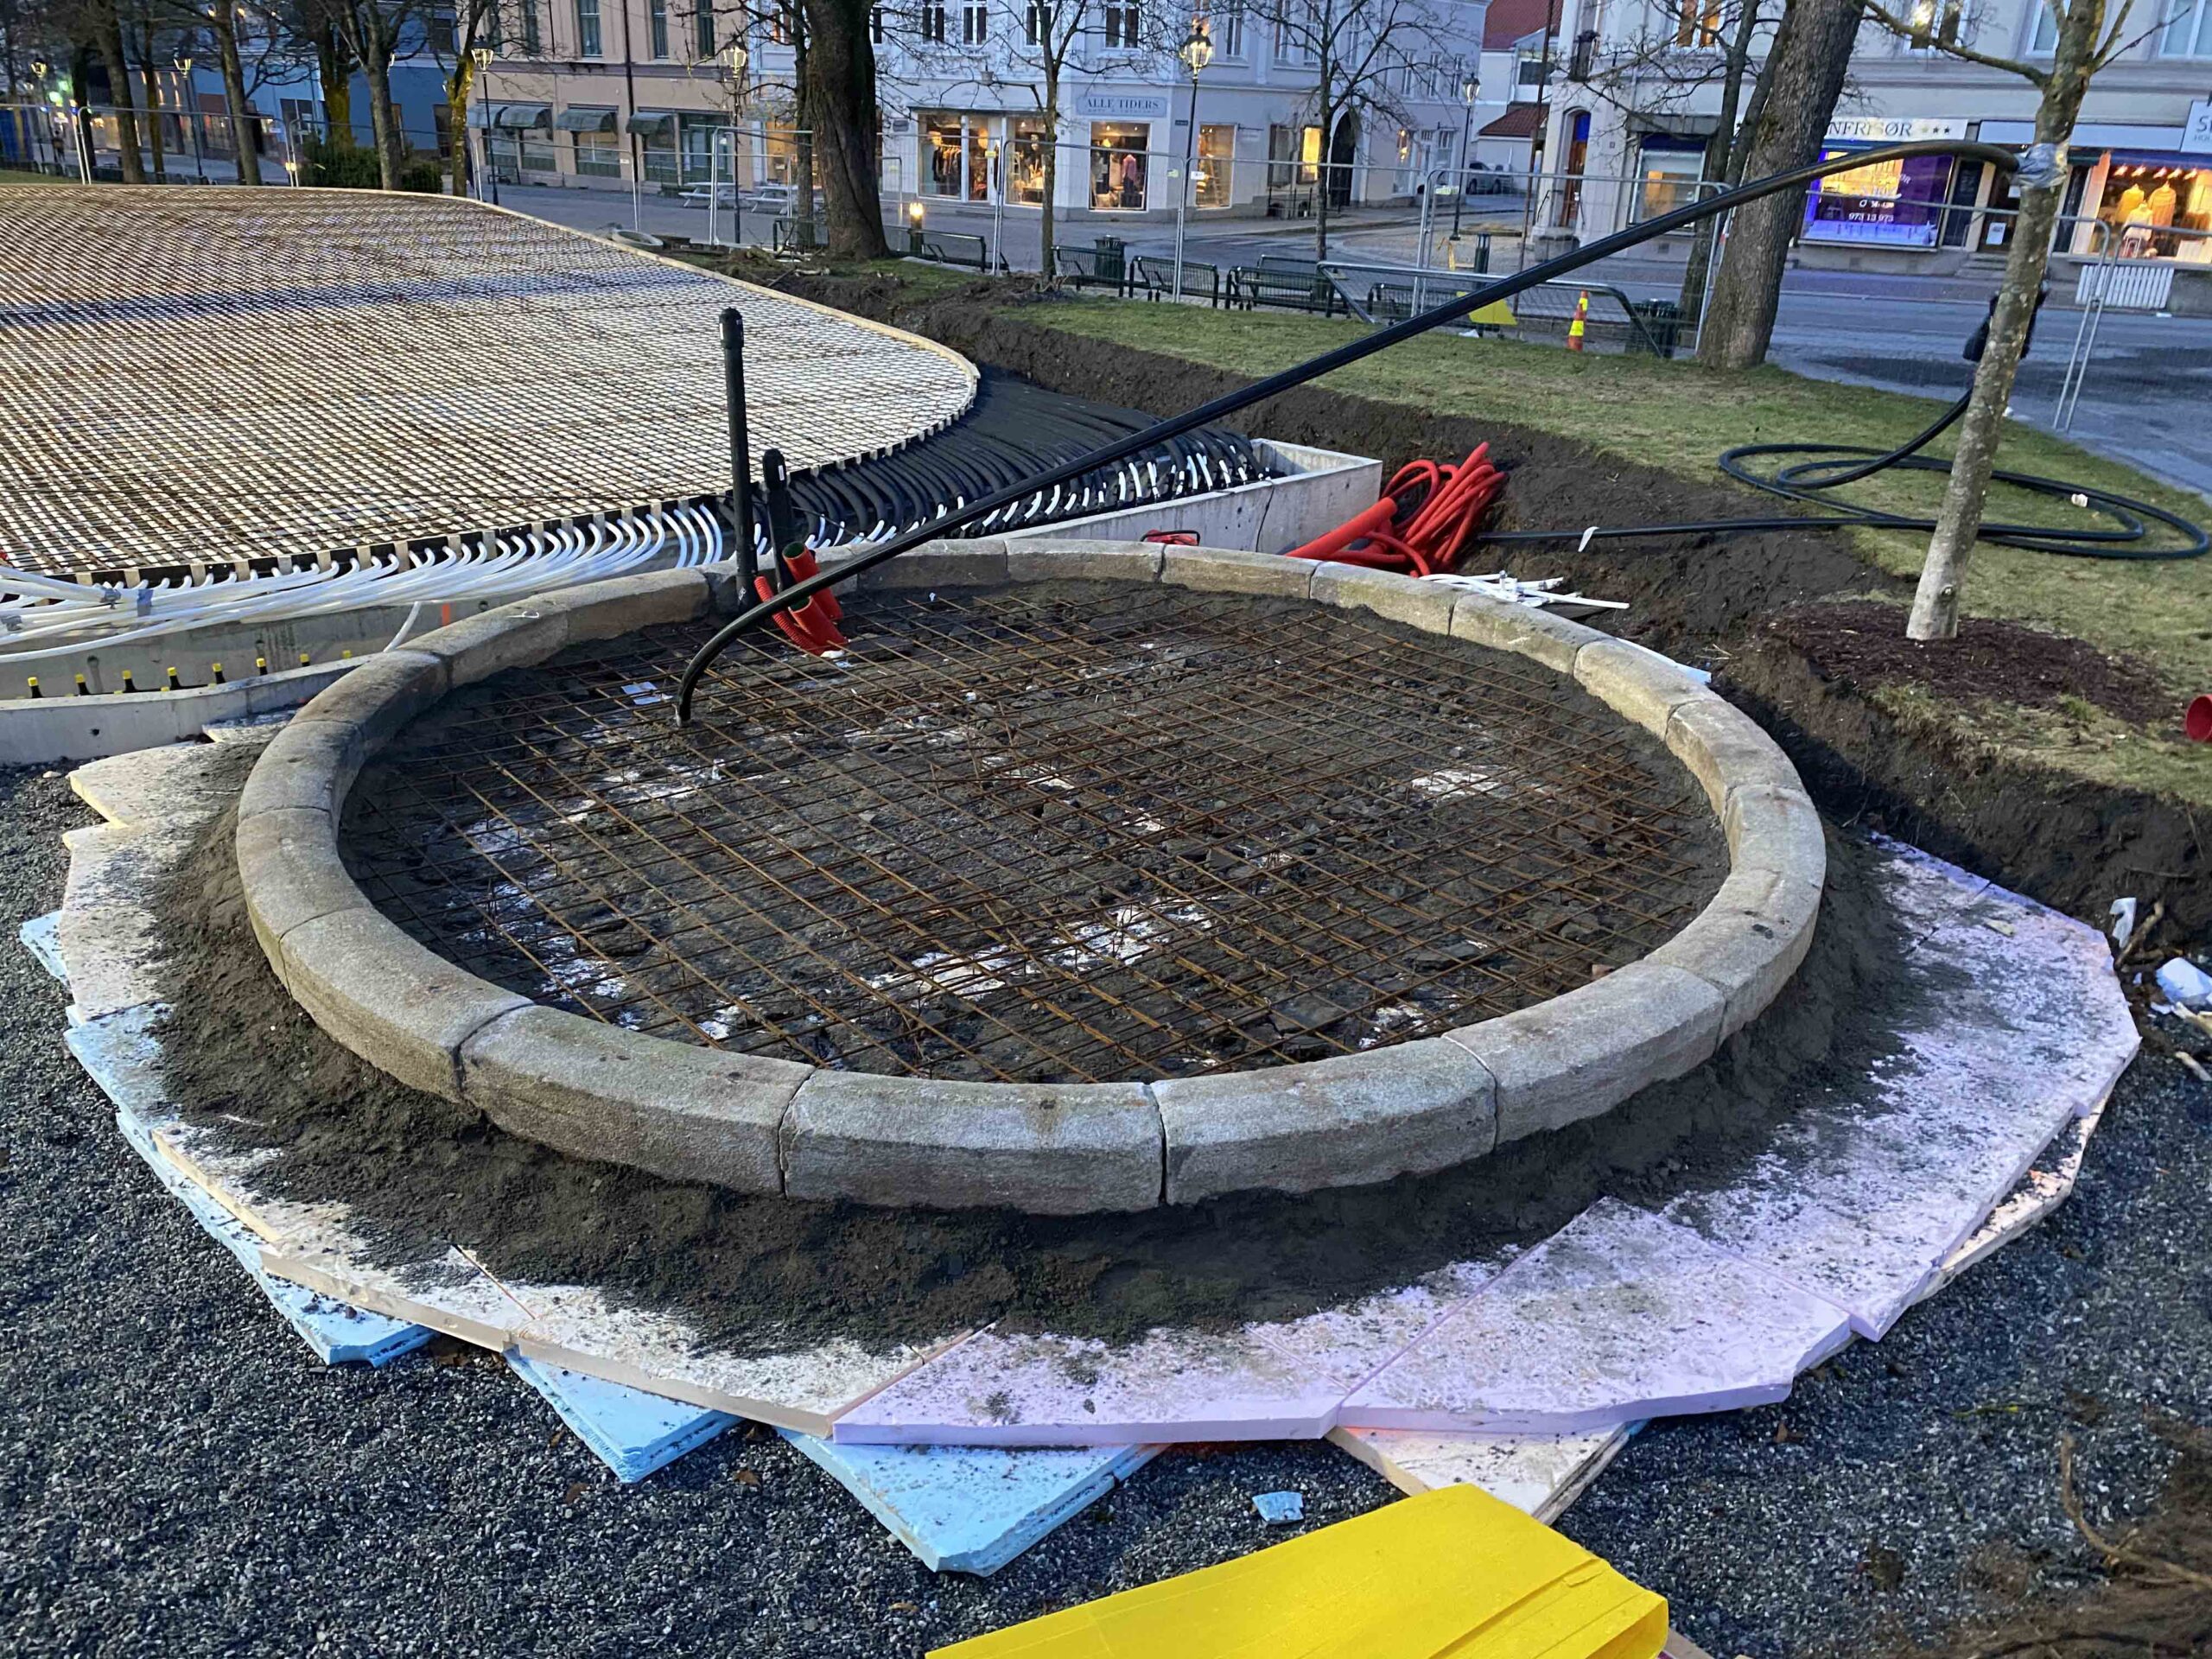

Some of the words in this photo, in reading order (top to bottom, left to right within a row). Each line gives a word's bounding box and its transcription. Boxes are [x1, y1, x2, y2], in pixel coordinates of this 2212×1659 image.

[1088, 99, 1114, 108] ALLE
[1119, 99, 1159, 109] TIDERS
[1827, 120, 1913, 137] NFRISØR
